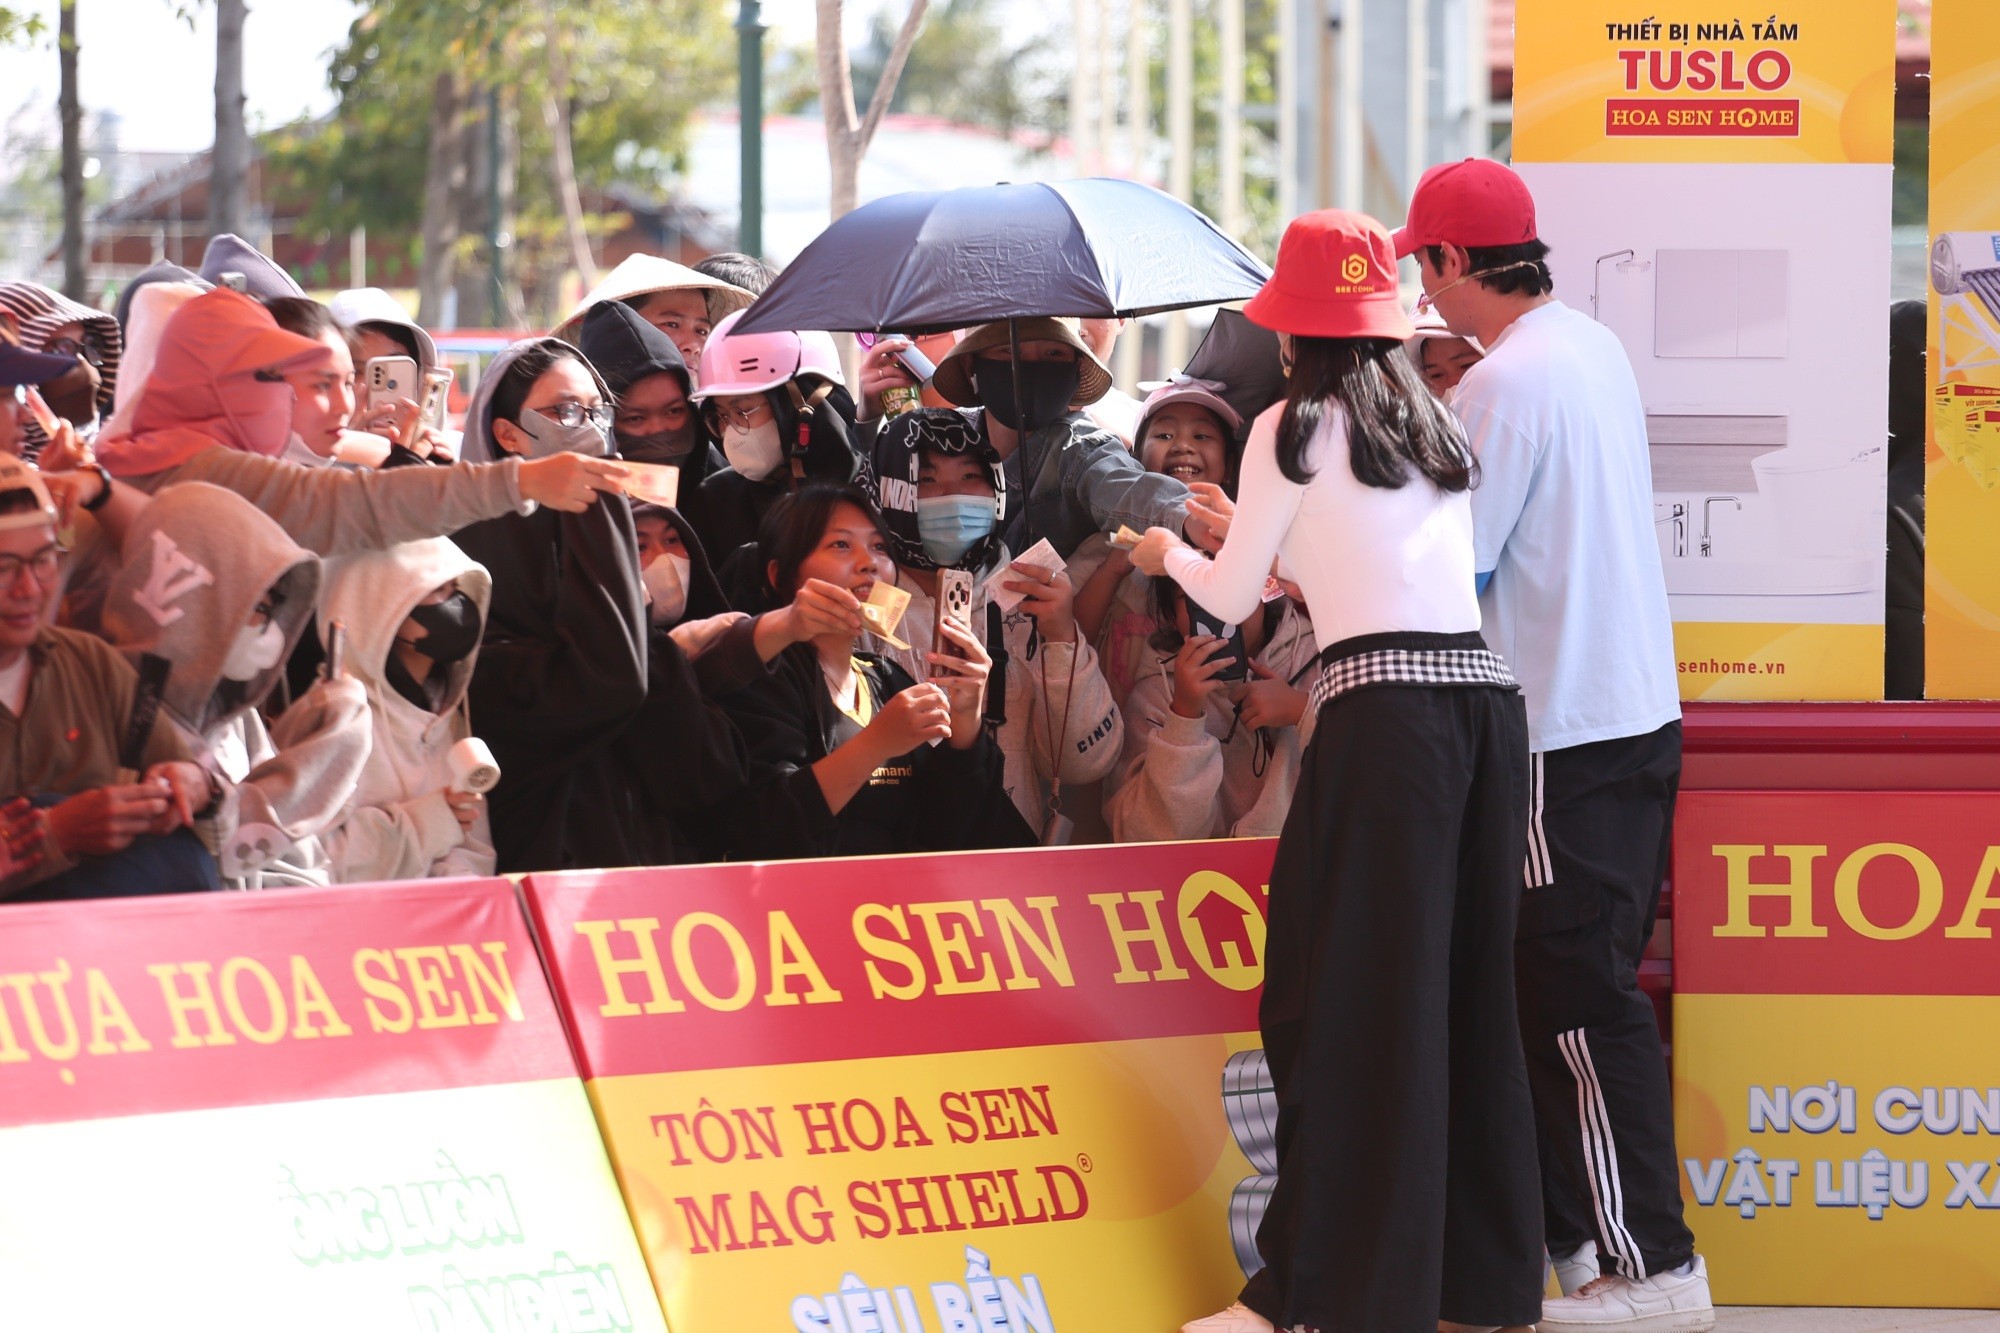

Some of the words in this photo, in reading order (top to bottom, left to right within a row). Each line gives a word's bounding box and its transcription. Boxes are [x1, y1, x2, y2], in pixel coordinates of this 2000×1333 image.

[1606, 15, 1662, 41] THIẾT
[1669, 23, 1689, 46] BỊ
[1696, 18, 1745, 41] NHÀ
[1752, 15, 1798, 41] TẮM
[1618, 49, 1791, 91] TUSLO
[1611, 109, 1661, 127] HOA
[1667, 109, 1713, 127] SEN
[1719, 107, 1794, 128] HOME
[574, 909, 844, 1018] HOA
[851, 895, 1076, 1001] SEN
[146, 955, 354, 1049] HOA
[351, 941, 525, 1034] SEN
[650, 1096, 784, 1166] TÔN
[792, 1096, 933, 1156] HOA
[938, 1085, 1060, 1144] SEN
[1748, 1079, 1857, 1135] NƠI
[674, 1184, 837, 1255] MAG
[1683, 1147, 1800, 1219] VẬT
[1814, 1147, 1929, 1221] LIỆU
[790, 1271, 925, 1333] SIÊU
[929, 1244, 1057, 1333] BỀN
